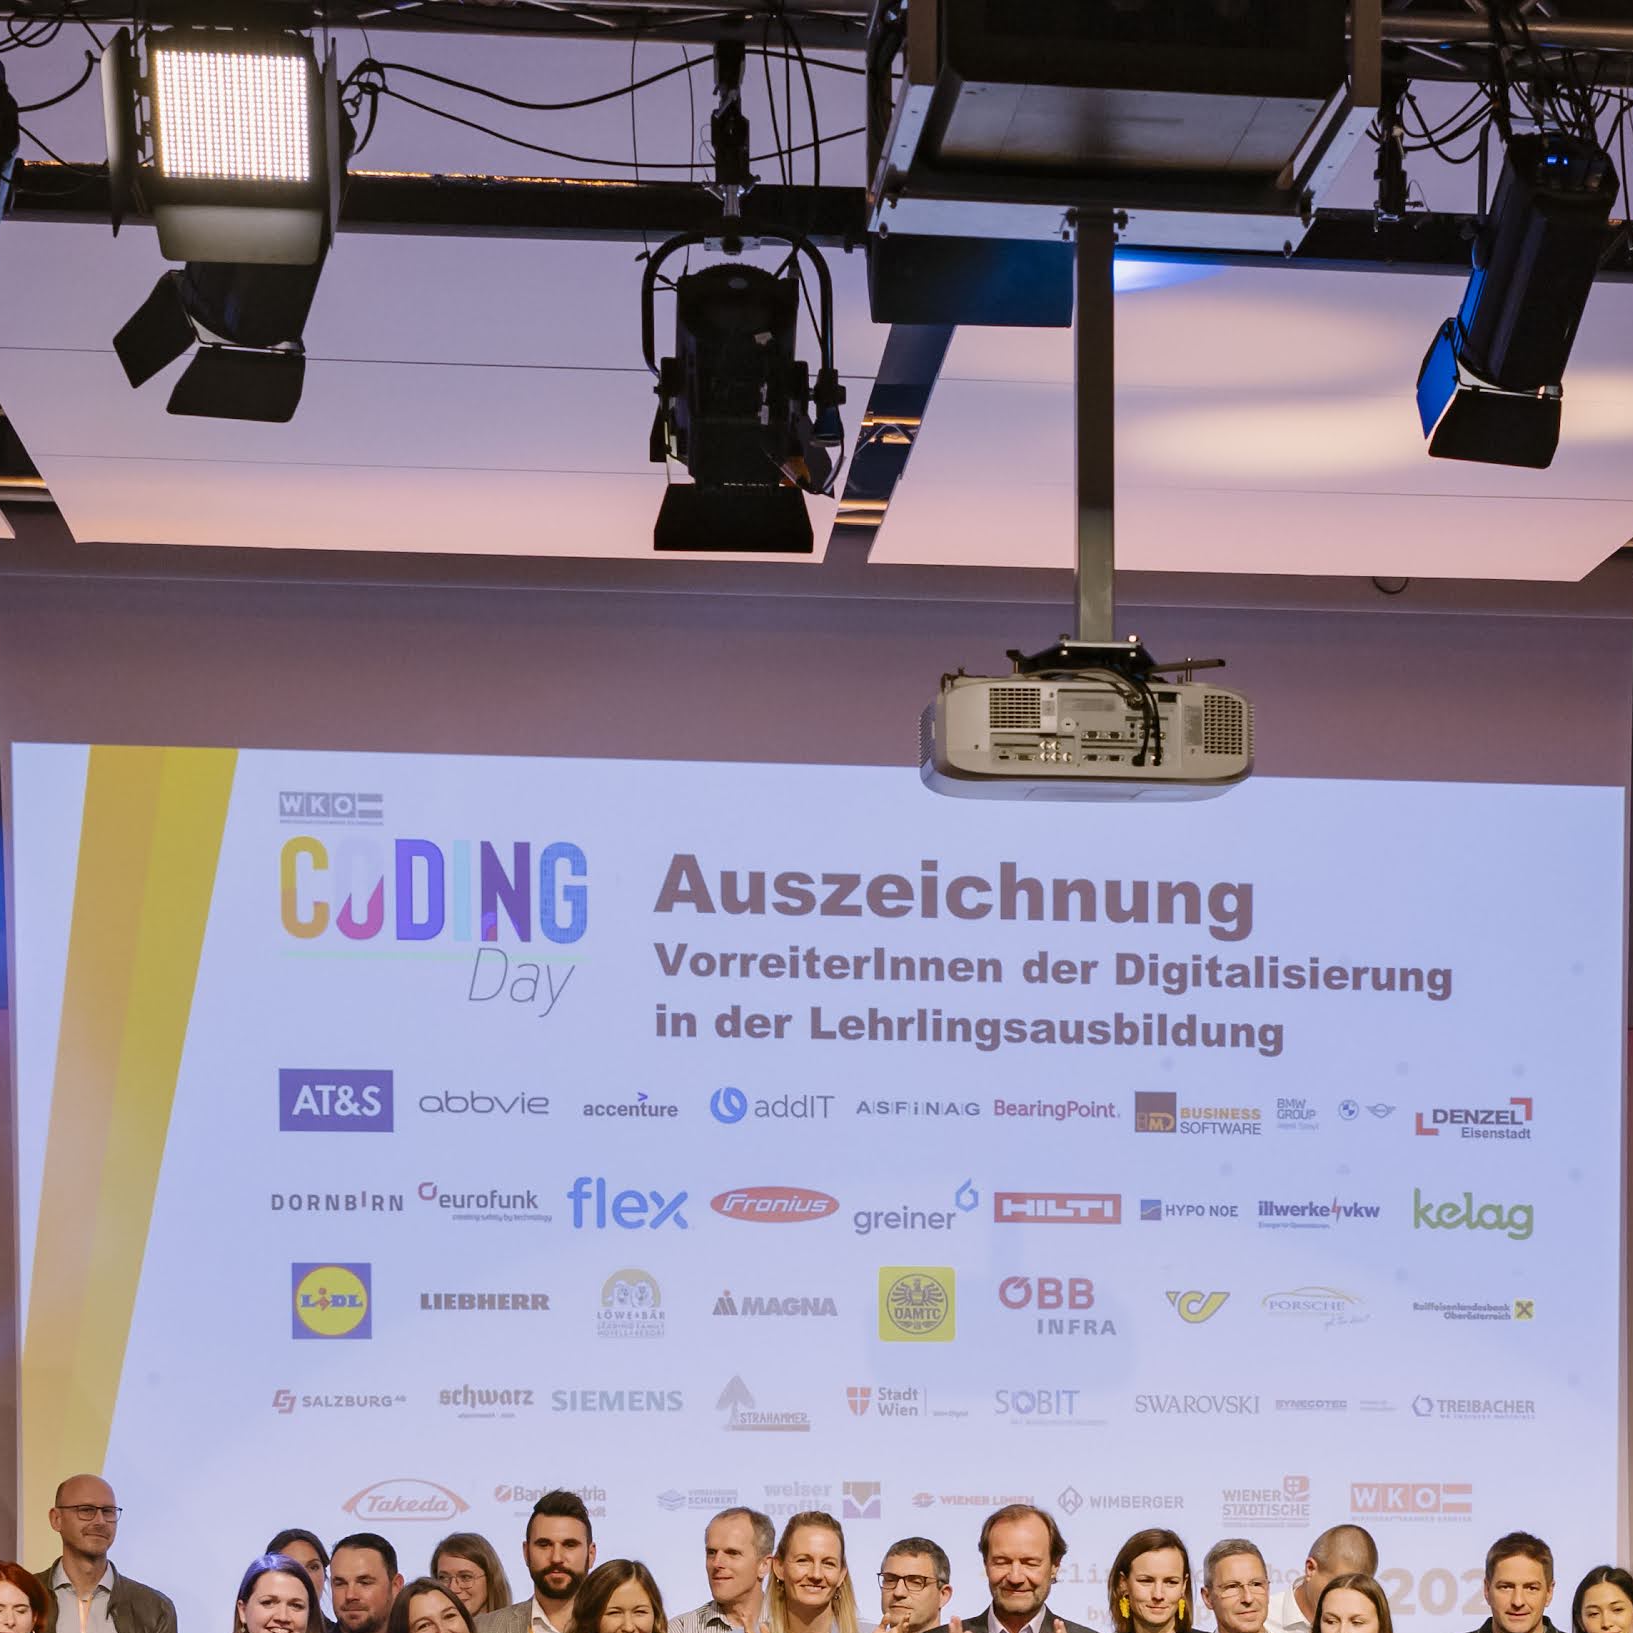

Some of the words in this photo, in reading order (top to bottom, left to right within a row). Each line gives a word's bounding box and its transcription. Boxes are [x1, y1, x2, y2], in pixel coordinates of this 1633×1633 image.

[282, 793, 353, 817] WKO
[653, 854, 1253, 945] Auszeichnung
[654, 943, 1002, 982] VorreiterInnen
[1023, 951, 1099, 984] der
[1116, 953, 1452, 1001] Digitalisierung
[469, 948, 575, 1018] Day
[656, 1004, 696, 1037] in
[715, 1005, 792, 1039] der
[811, 1007, 1283, 1057] Lehrlingsausbildung
[291, 1084, 383, 1117] AT&S
[419, 1090, 549, 1114] abbvie
[583, 1099, 678, 1117] accenture
[755, 1094, 835, 1118] addIT
[1275, 1097, 1308, 1110] BMW
[1180, 1107, 1261, 1122] BUSINESS
[1275, 1109, 1318, 1121] GROUP
[1431, 1107, 1524, 1126] DENZEL
[1180, 1119, 1261, 1135] SOFTWARE
[1461, 1127, 1531, 1139] Eisenstadt
[439, 1190, 538, 1209] eurofunk
[567, 1176, 688, 1229] flex
[721, 1193, 830, 1215] Fronius
[1003, 1199, 1114, 1219] HILTI
[1259, 1201, 1330, 1217] illwerke
[854, 1204, 958, 1235] greiner
[1166, 1204, 1205, 1216] HYPO
[1210, 1205, 1238, 1217] NOE
[1414, 1188, 1533, 1240] kelag
[301, 1288, 363, 1311] LIDL
[421, 1293, 549, 1310] LIEBHERR
[999, 1276, 1094, 1310] ÖBB
[741, 1297, 838, 1316] MAGNA
[1267, 1299, 1348, 1313] PORSCHE
[1038, 1319, 1116, 1335] INFRA
[302, 1395, 392, 1407] SALZBURG
[440, 1384, 534, 1408] schwarz
[552, 1390, 683, 1411] SIEMENS
[878, 1387, 918, 1400] Stadt
[996, 1389, 1080, 1416] SOBIT
[878, 1403, 918, 1416] Wien
[1136, 1395, 1259, 1414] SWAROVSKI
[1437, 1400, 1535, 1416] TREIBACHER
[762, 1481, 832, 1500] weiser
[1222, 1488, 1284, 1504] WIENER
[1353, 1485, 1442, 1510] WKO
[366, 1494, 450, 1512] Takeda
[1090, 1496, 1184, 1509] WIMBERGER
[1221, 1502, 1311, 1519] STÄDTISCHE
[1379, 1567, 1485, 1615] 202
